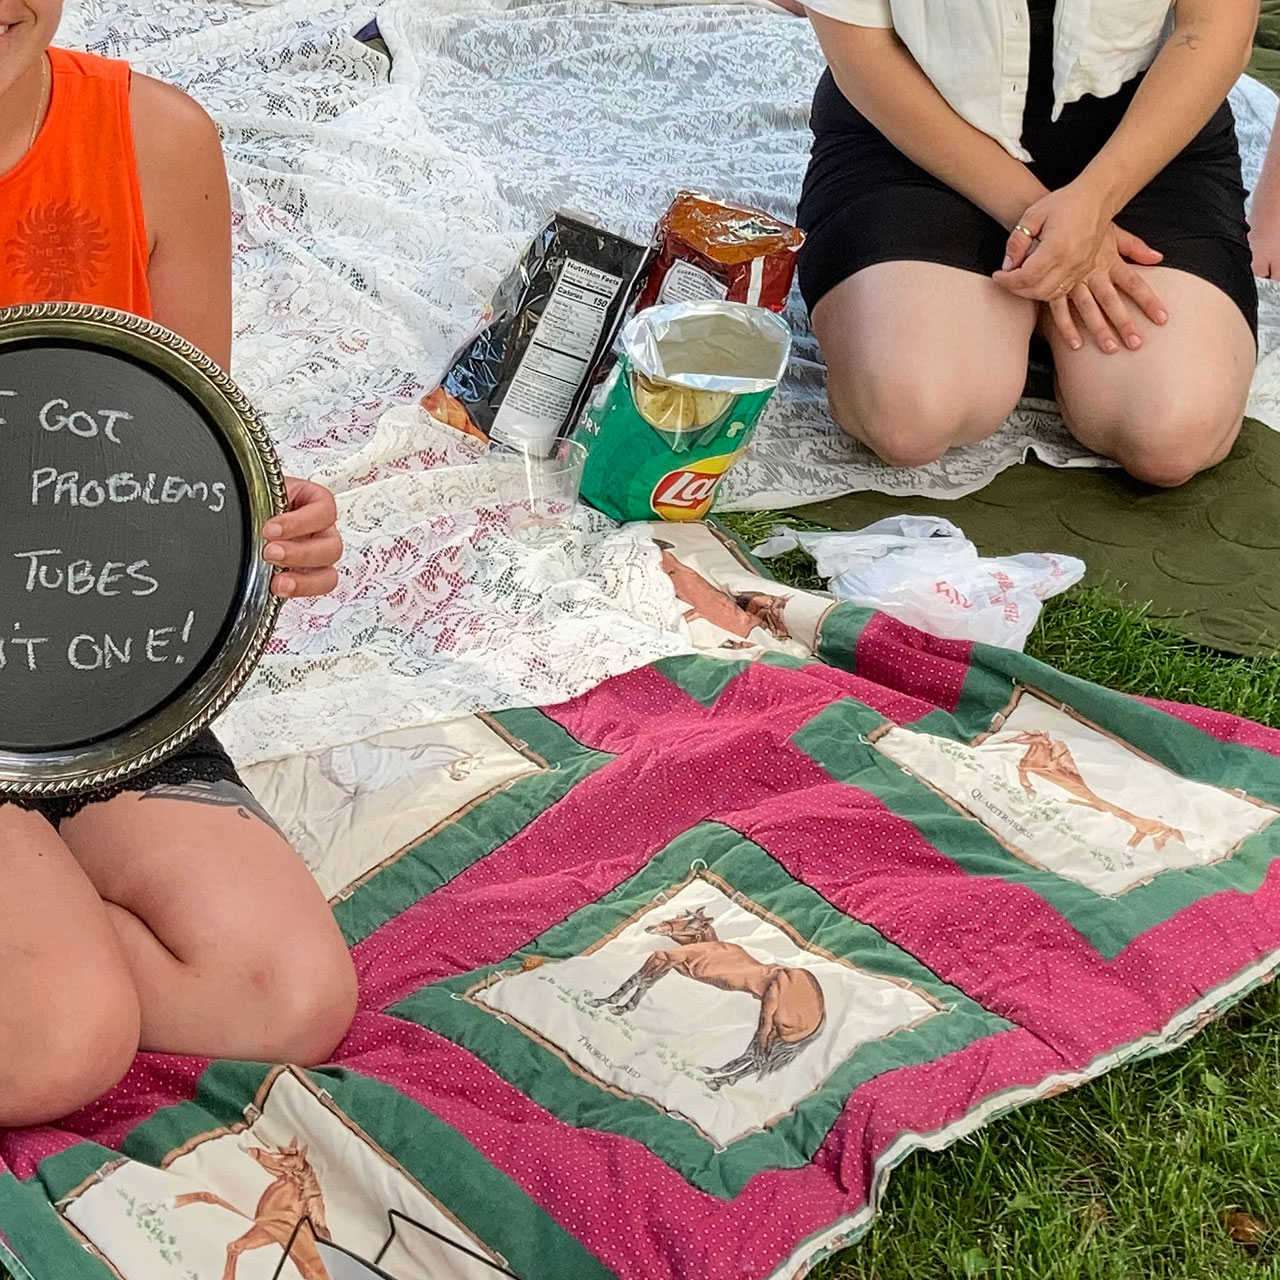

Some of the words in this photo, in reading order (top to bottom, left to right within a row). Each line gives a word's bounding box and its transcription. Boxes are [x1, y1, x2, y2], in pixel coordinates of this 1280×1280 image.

[567, 261, 601, 280] Nutrition
[601, 274, 620, 286] Facts
[557, 286, 583, 300] Calories
[593, 297, 608, 308] 150
[39, 398, 134, 444] GOT
[656, 471, 718, 508] La
[14, 548, 160, 597] TUBES
[68, 610, 195, 670] ONE!
